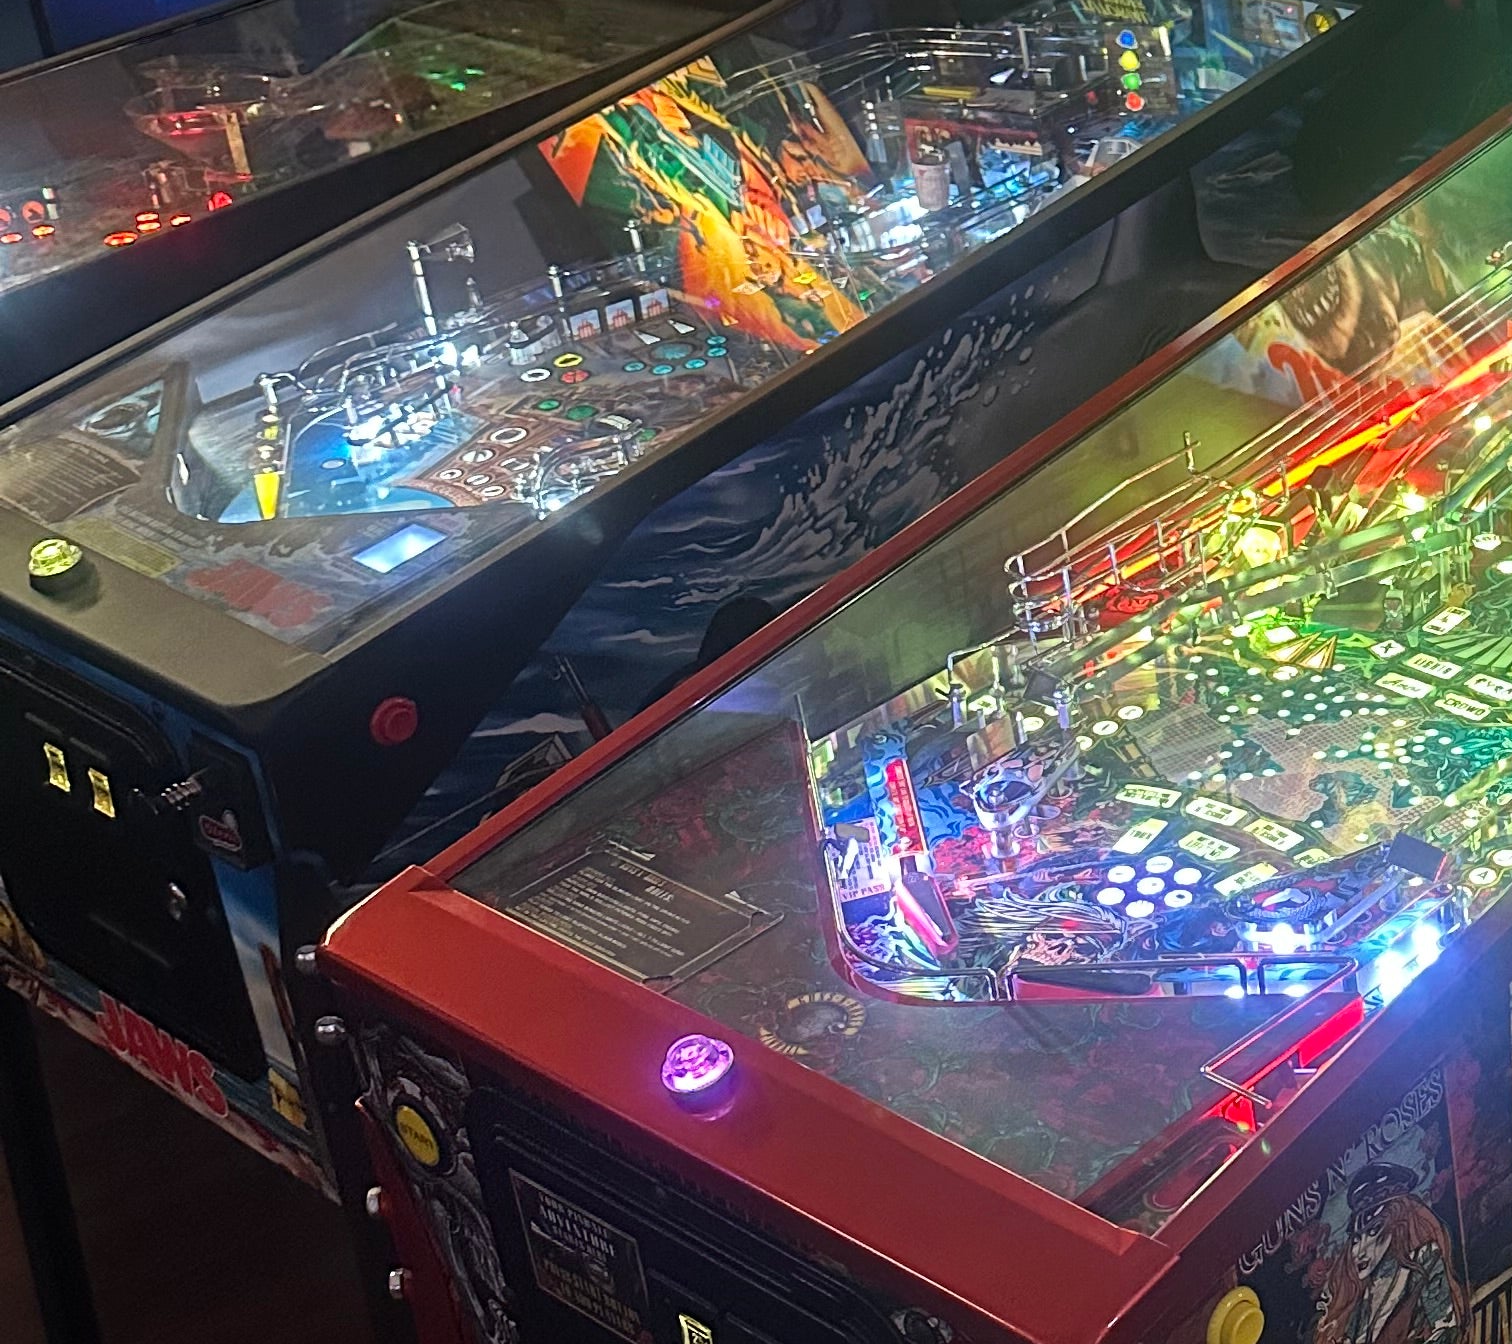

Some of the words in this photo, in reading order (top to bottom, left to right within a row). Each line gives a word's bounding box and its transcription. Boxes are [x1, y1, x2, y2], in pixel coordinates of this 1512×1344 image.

[399, 1121, 435, 1150] START
[1238, 1179, 1323, 1275] GUNS
[1363, 1067, 1444, 1161] ROSES
